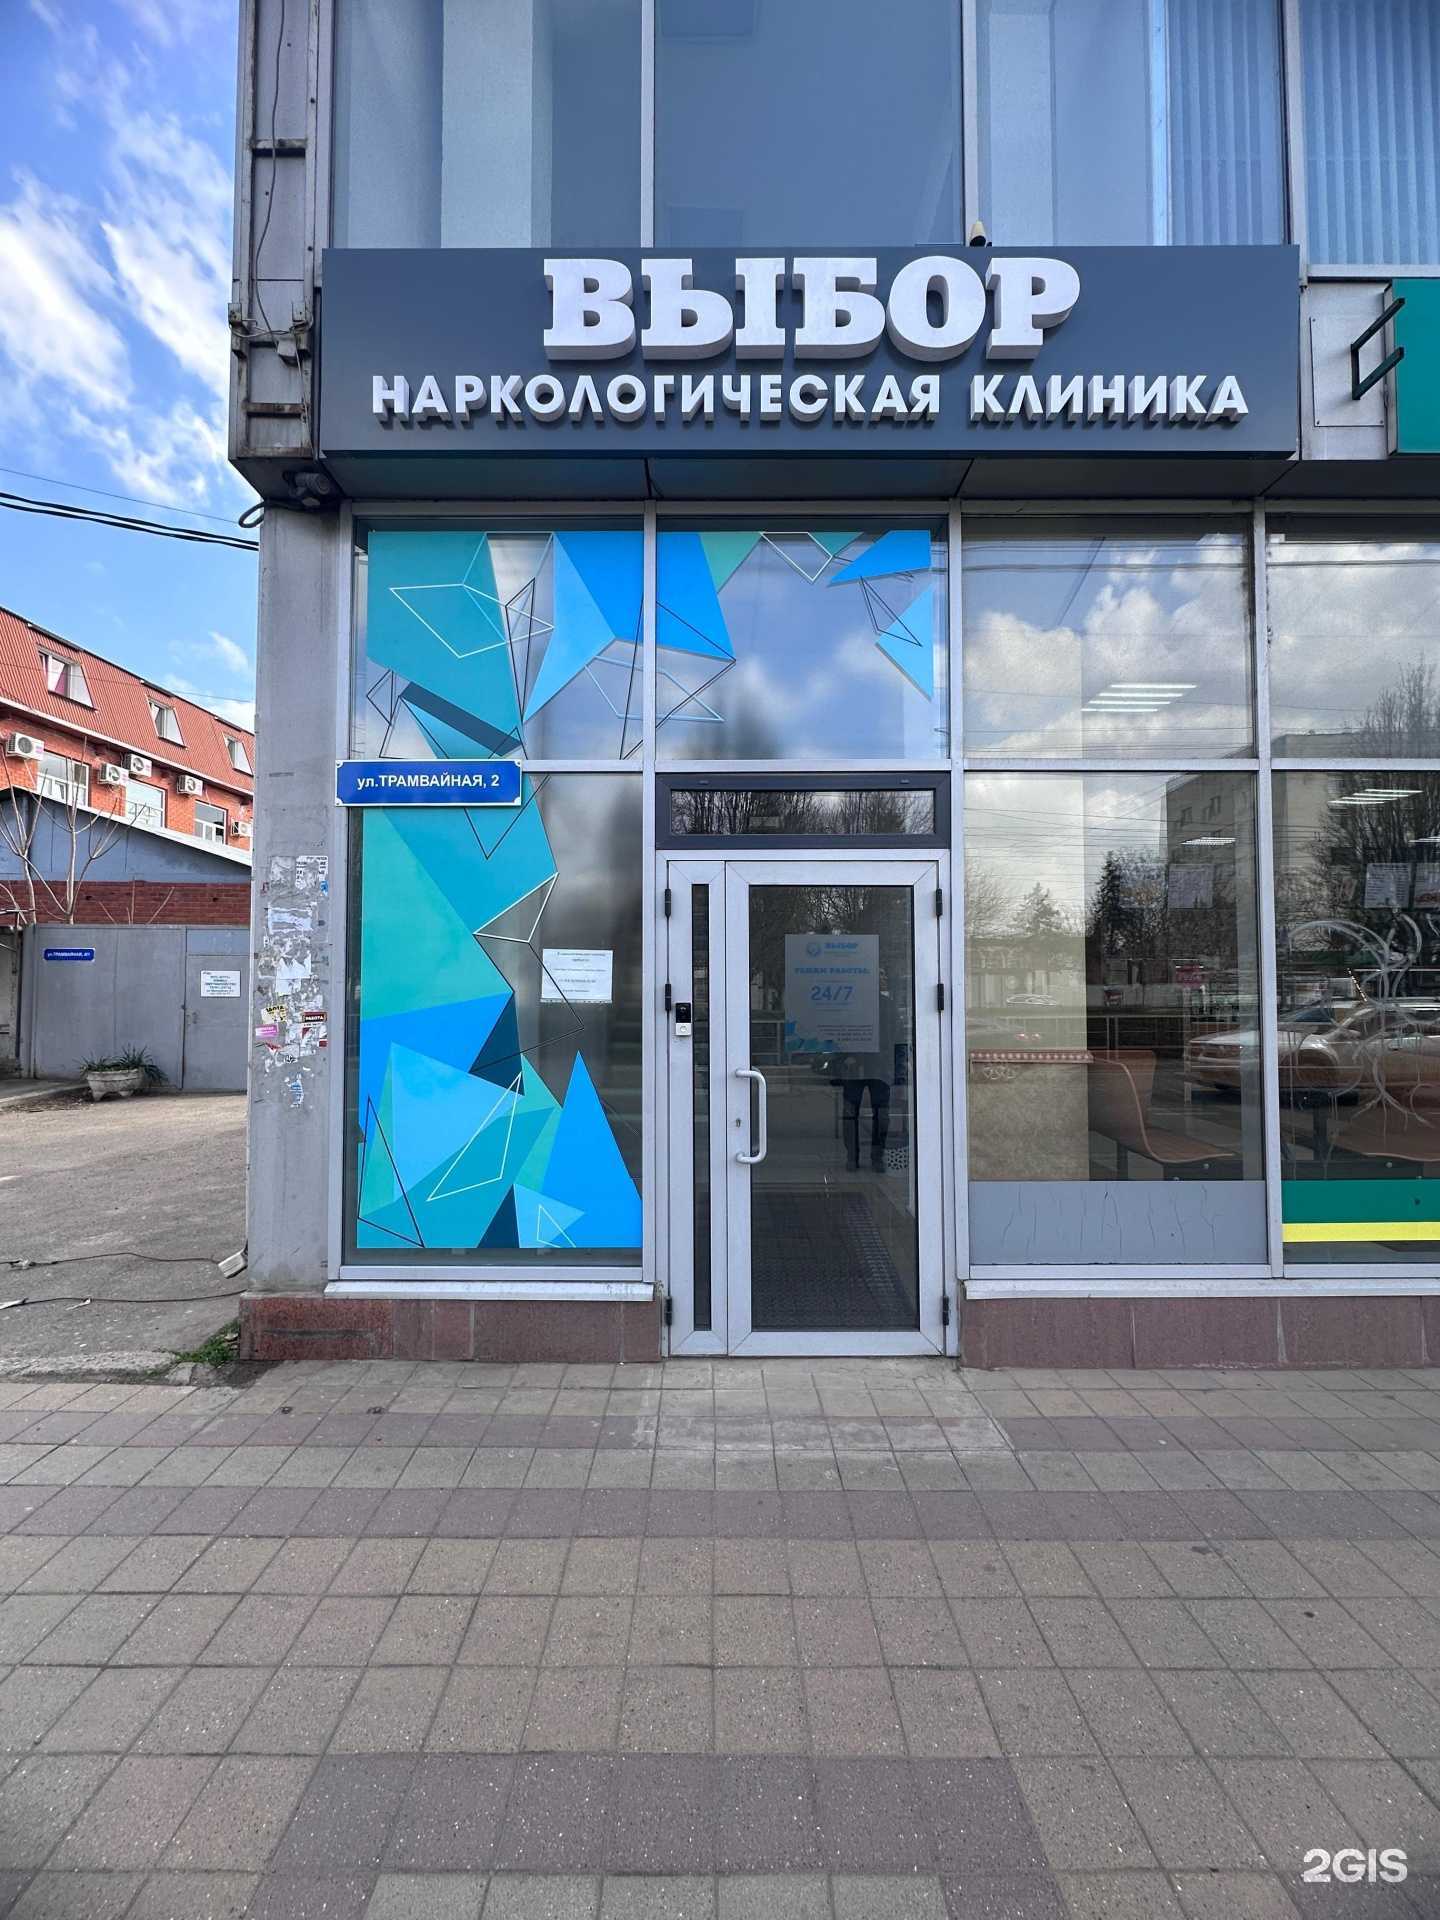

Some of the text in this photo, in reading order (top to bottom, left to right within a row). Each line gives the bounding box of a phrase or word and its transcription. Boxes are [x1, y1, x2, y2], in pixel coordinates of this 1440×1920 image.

[543, 256, 1081, 361] ВЫБОР
[372, 374, 1249, 422] НАРКОЛОГИЧЕСКАЯ КЛИНИКА
[491, 774, 500, 787] 2
[811, 985, 854, 1001] 24/7
